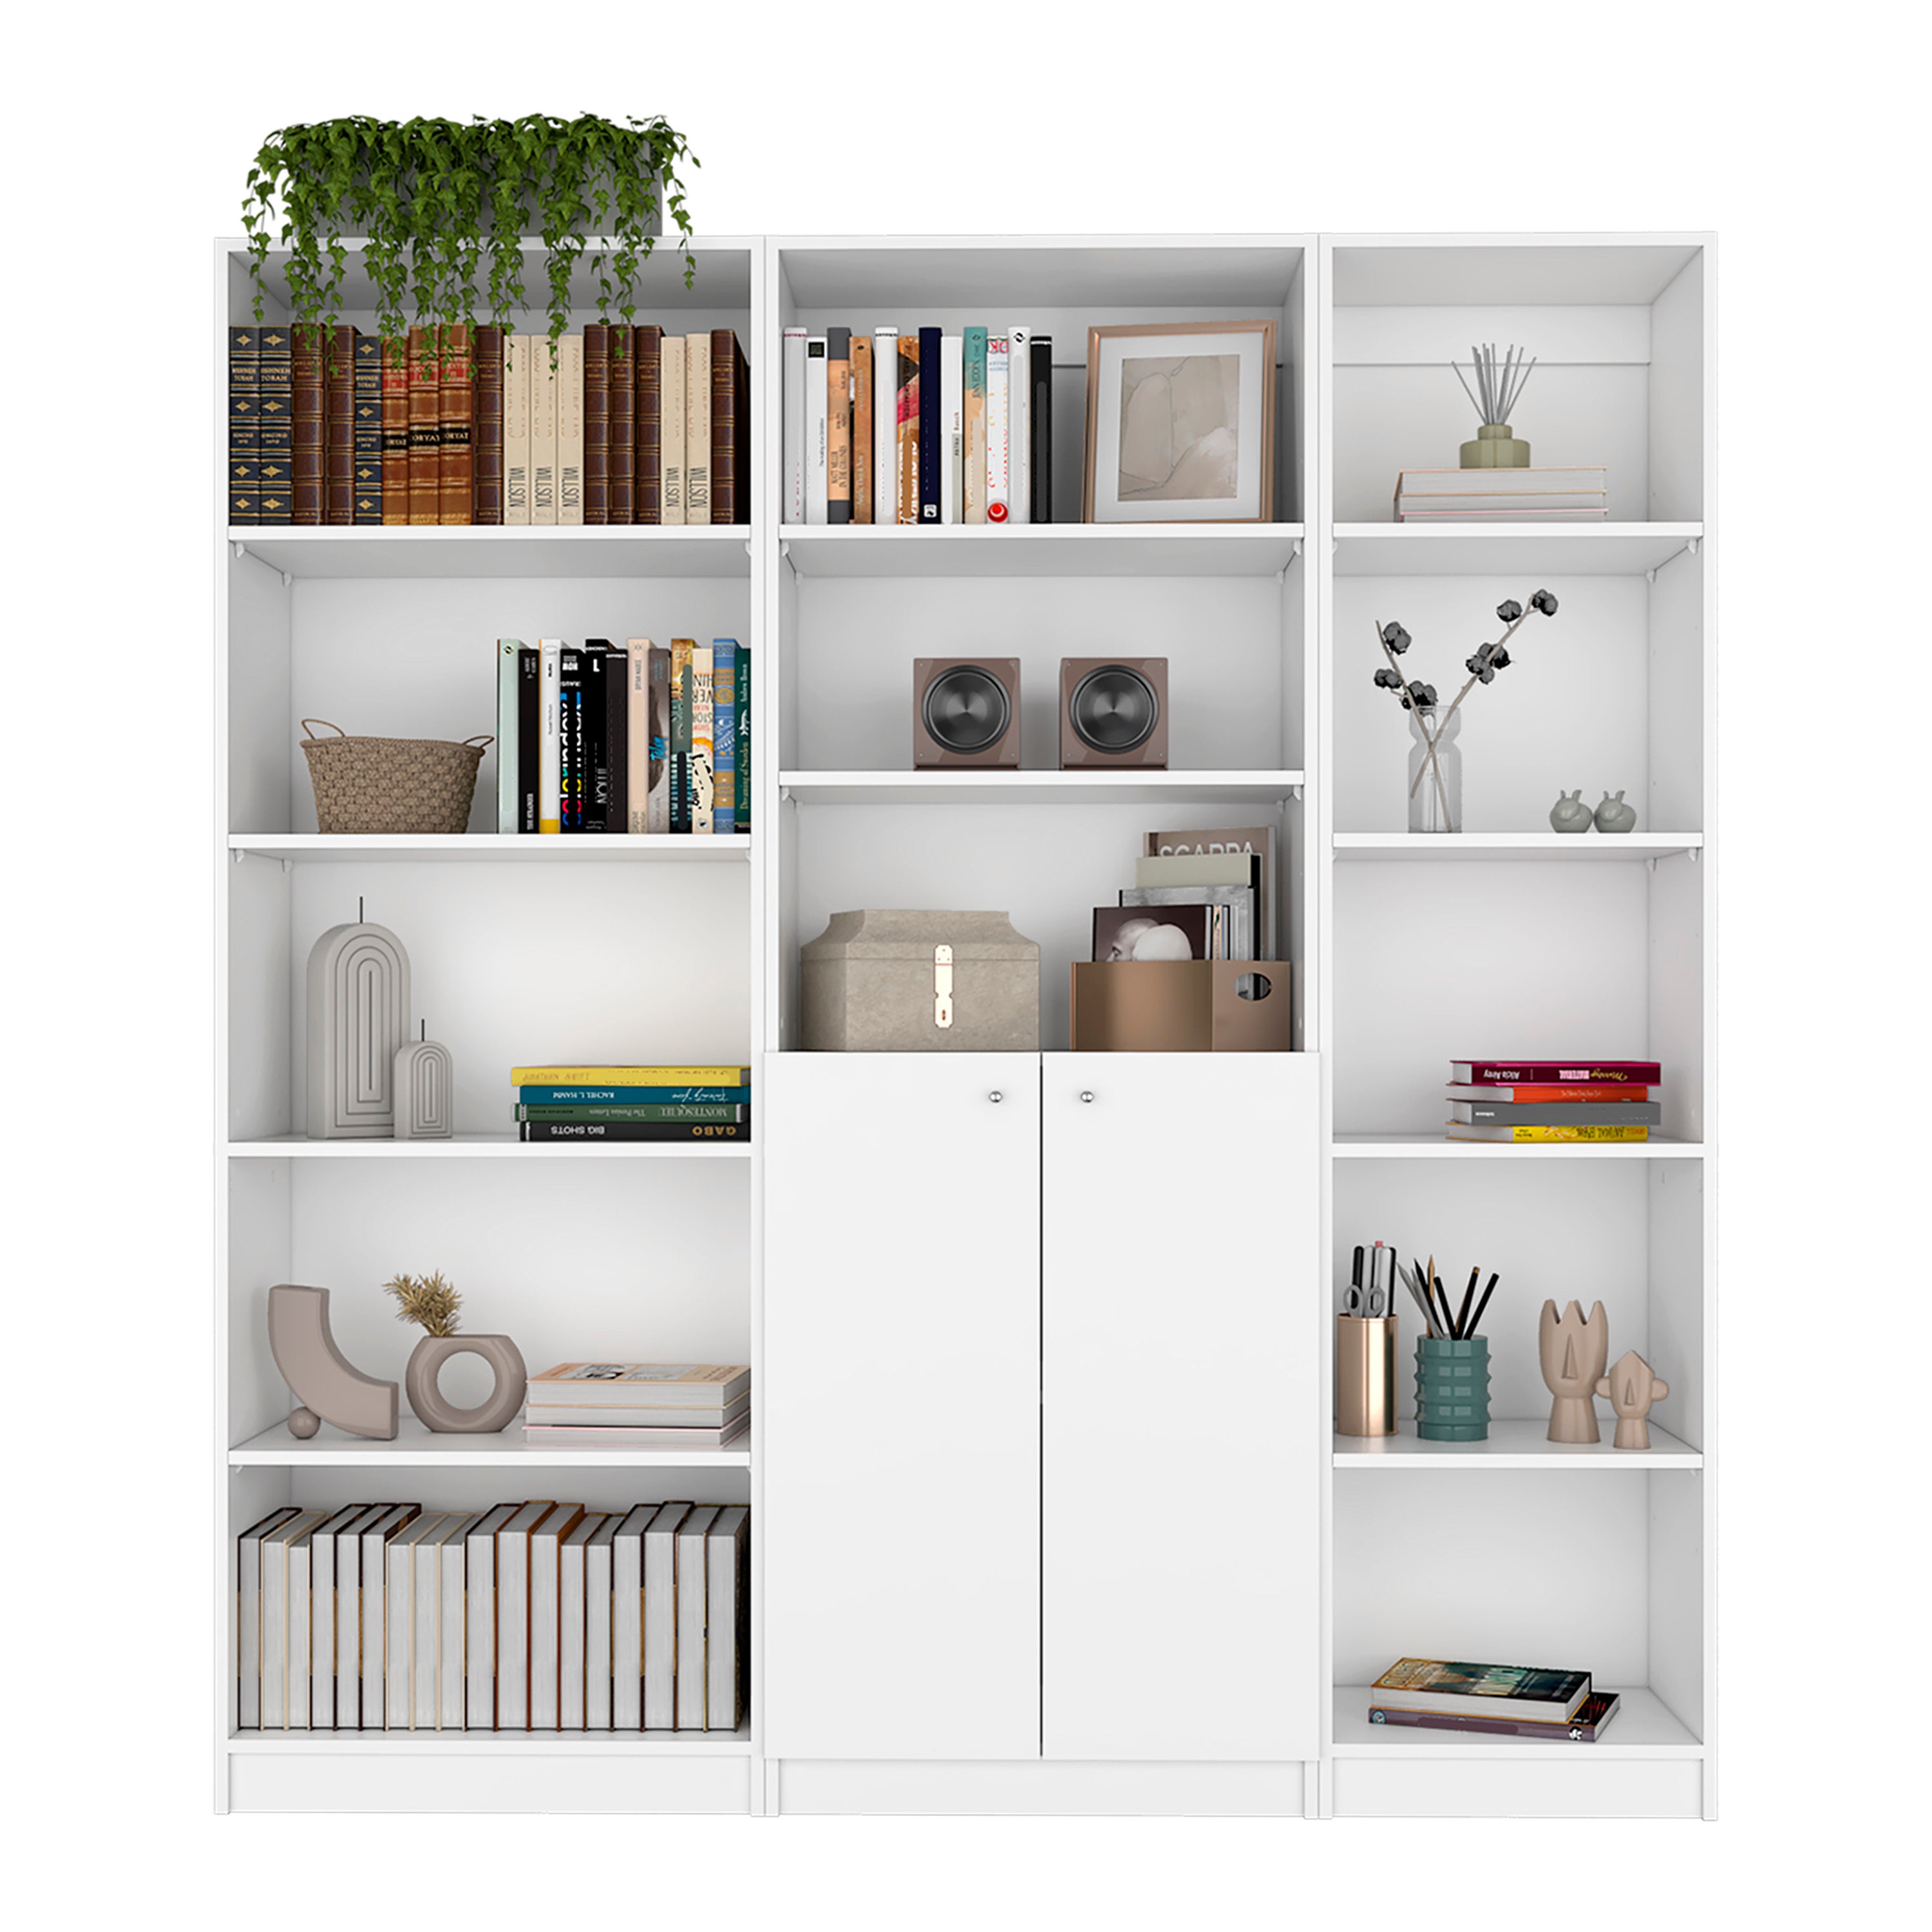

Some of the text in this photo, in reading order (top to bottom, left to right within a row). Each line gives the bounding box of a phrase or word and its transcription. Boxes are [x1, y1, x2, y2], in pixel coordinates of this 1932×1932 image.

[658, 1104, 727, 1117] MONTESQUIEU
[551, 1126, 605, 1135] BIG SHOTS
[692, 1126, 737, 1135] GABO
